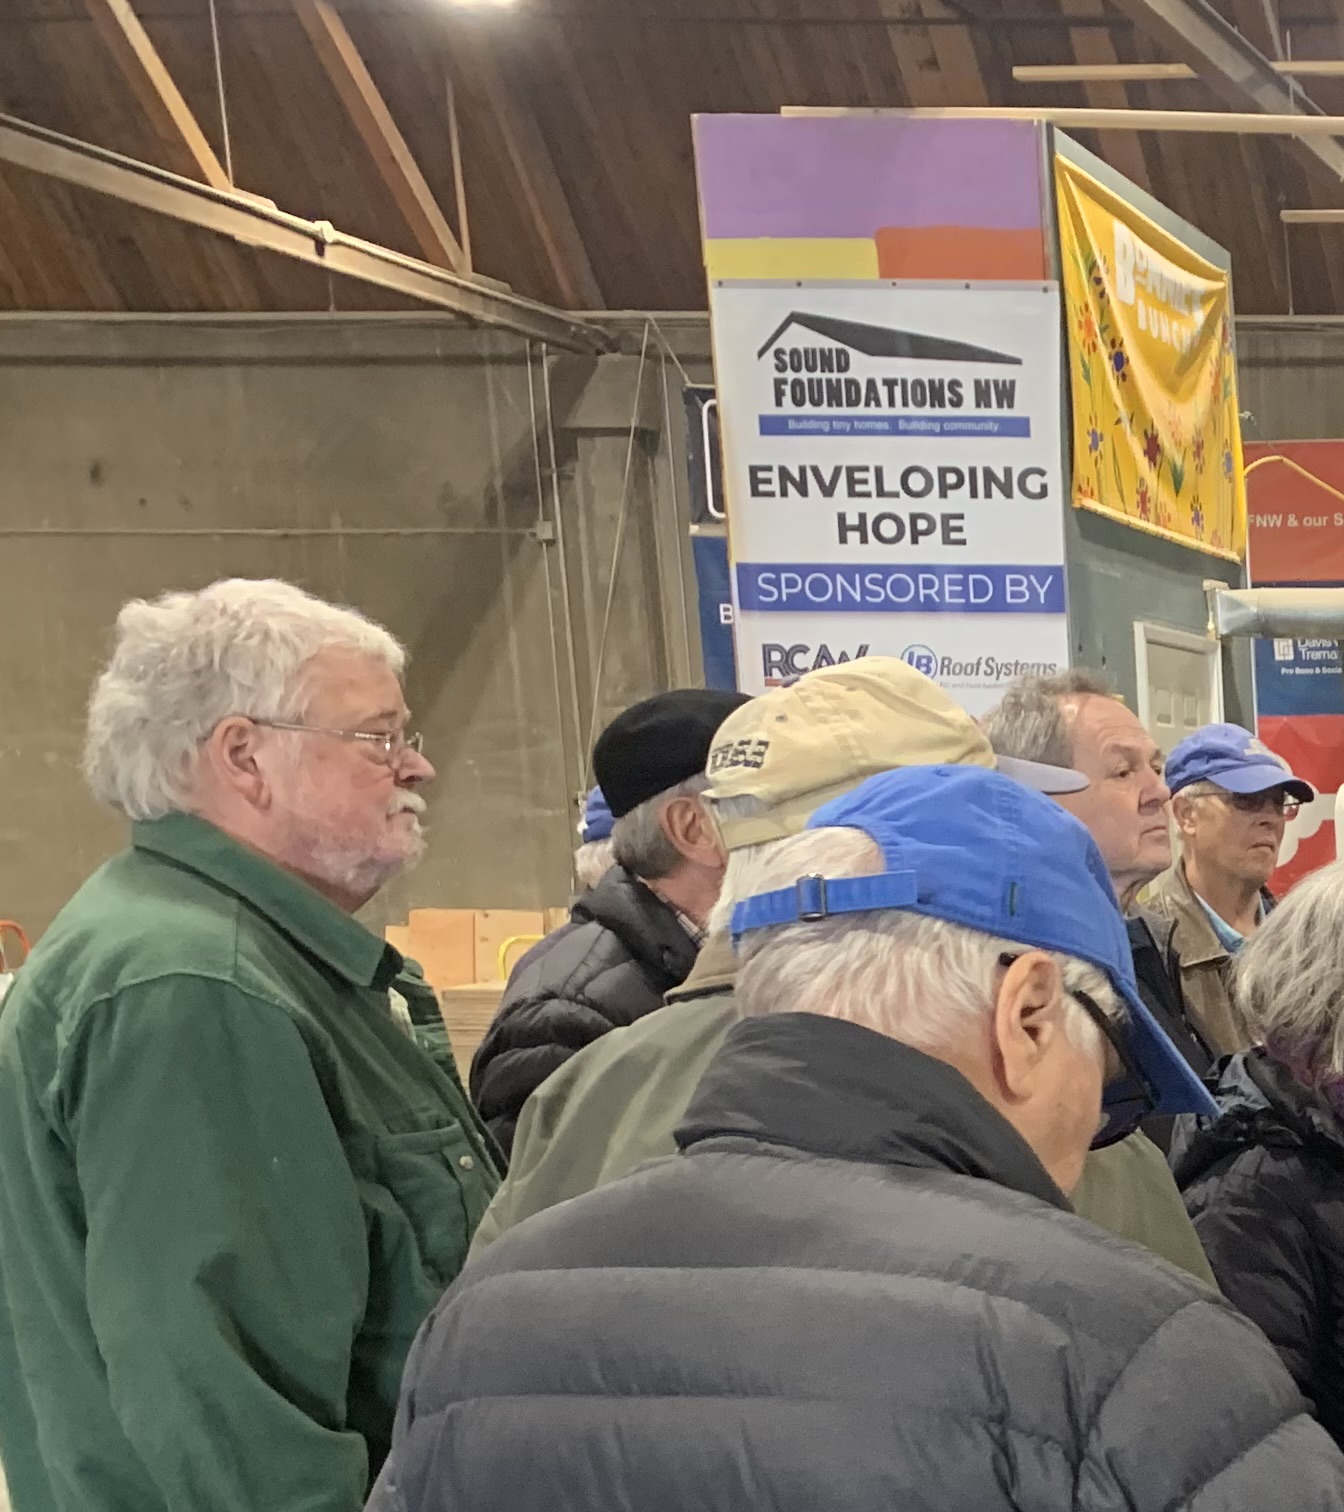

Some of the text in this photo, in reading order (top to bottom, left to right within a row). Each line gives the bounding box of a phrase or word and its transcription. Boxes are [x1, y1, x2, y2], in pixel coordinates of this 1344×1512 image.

[773, 347, 850, 374] SOUND
[773, 377, 1016, 409] FOUNDATIONS NW
[788, 419, 829, 432] Building
[832, 419, 851, 433] tiny
[898, 419, 941, 433] Building
[748, 464, 1049, 501] ENVELOPING
[837, 512, 967, 547] HOPE
[1288, 514, 1299, 527] &
[1303, 515, 1327, 528] our
[757, 572, 1054, 605] SPONSORED BY
[940, 656, 982, 676] Roof
[984, 656, 1057, 681] Systems
